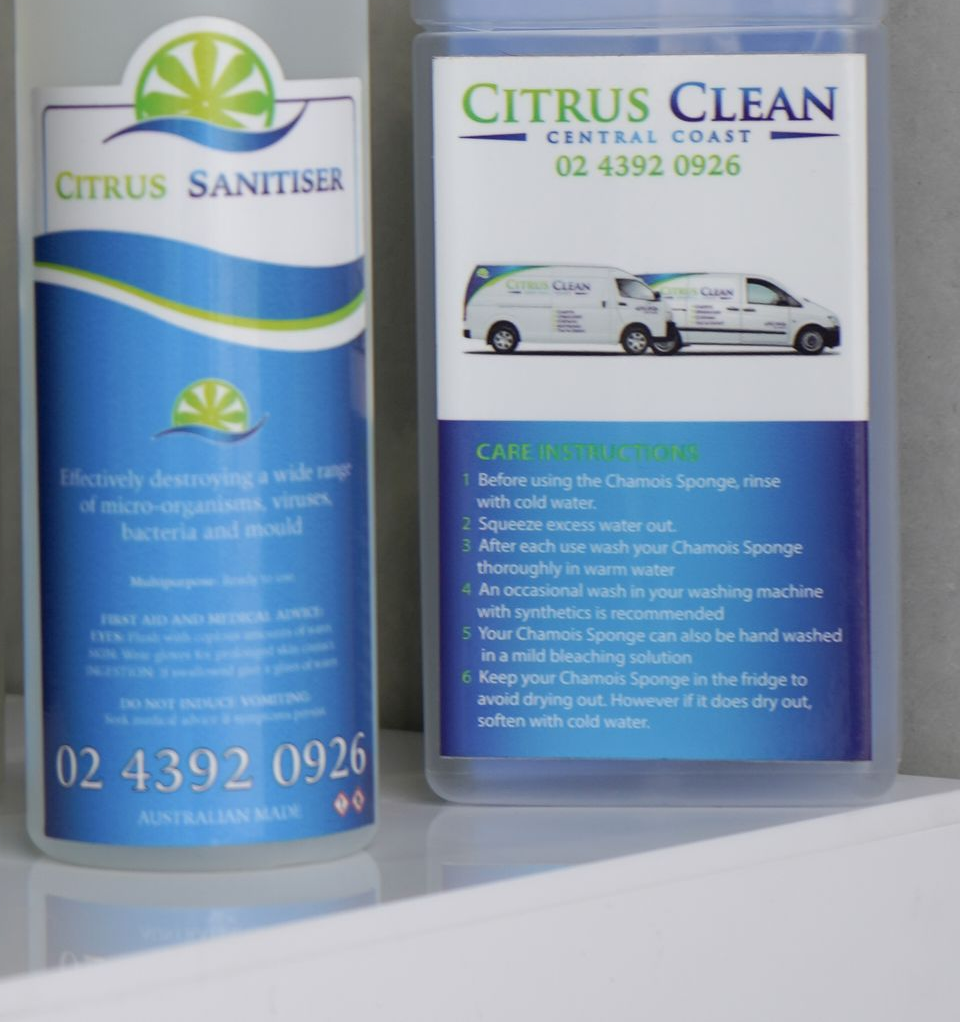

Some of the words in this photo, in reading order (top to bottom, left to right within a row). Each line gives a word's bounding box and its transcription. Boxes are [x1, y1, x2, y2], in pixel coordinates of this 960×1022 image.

[461, 82, 650, 124] CITRUS
[669, 81, 839, 123] CLEAN
[546, 129, 658, 145] CENTRAL
[671, 128, 752, 144] COAST
[555, 154, 588, 177] 02
[597, 154, 665, 177] 4392
[674, 153, 741, 176] 0926
[54, 170, 167, 200] CITRUS
[188, 167, 345, 198] SANITISER
[552, 280, 591, 291] CLEAN
[476, 443, 533, 461] CARE
[539, 443, 700, 463] INSTRUCTIONS
[60, 468, 143, 490] Effectively
[150, 469, 255, 491] destroying
[258, 472, 270, 485] a
[274, 464, 313, 482] wide
[478, 472, 528, 489] Before
[531, 474, 572, 492] using
[576, 473, 602, 489] the
[605, 473, 673, 490] Chamois
[676, 474, 739, 492] Sponge,
[743, 475, 781, 490] rinse
[79, 496, 97, 514] of
[477, 494, 510, 510] with
[514, 495, 547, 510] cold
[550, 497, 597, 511] water.
[121, 521, 198, 542] bacteria
[202, 520, 241, 541] and
[245, 515, 303, 538] mould
[461, 518, 471, 531] 2
[478, 517, 542, 533] Squeeze
[546, 521, 596, 533] excess
[598, 520, 643, 534] water
[645, 521, 677, 534] out.
[461, 539, 471, 553] 3
[478, 538, 516, 554] After
[519, 539, 556, 555] each
[559, 543, 587, 555] use
[590, 539, 629, 555] wash
[632, 543, 668, 559] your
[671, 539, 739, 556] Chamois
[743, 540, 804, 559] Sponge
[477, 560, 562, 580] thoroughly
[566, 561, 580, 576] in
[584, 564, 628, 576] warm
[631, 563, 675, 577] water
[461, 583, 472, 596] 4
[478, 583, 500, 597] An
[504, 582, 583, 599] occasional
[587, 583, 627, 599] wash
[630, 584, 645, 599] in
[648, 586, 684, 602] your
[687, 585, 753, 602] washing
[757, 584, 824, 599] machine
[477, 605, 511, 620] with
[514, 605, 592, 623] synthetics
[596, 606, 608, 621] is
[610, 607, 725, 622] recommended
[461, 627, 471, 641] 5
[478, 627, 513, 641] Your
[516, 626, 583, 642] Chamois
[587, 628, 646, 645] Sponge
[649, 631, 677, 643] can
[681, 628, 712, 643] also
[715, 628, 736, 644] be
[739, 628, 779, 643] hand
[782, 628, 842, 644] washed
[481, 649, 496, 663] in
[499, 652, 509, 663] a
[512, 649, 546, 664] mild
[550, 649, 626, 667] bleaching
[630, 650, 692, 665] solution
[462, 672, 472, 685] 6
[479, 671, 518, 688] Keep
[521, 675, 556, 689] your
[560, 671, 626, 687] Chamois
[630, 671, 689, 690] Sponge
[693, 672, 708, 687] in
[711, 672, 738, 687] the
[741, 672, 788, 690] fridge
[790, 674, 808, 687] to
[477, 693, 520, 707] avoid
[523, 693, 574, 710] drying
[577, 695, 607, 708] out.
[610, 694, 680, 709] However
[683, 693, 695, 708] if
[697, 694, 708, 708] it
[711, 694, 748, 709] does
[751, 694, 778, 711] dry
[781, 696, 812, 711] out,
[477, 714, 526, 728] soften
[529, 714, 564, 729] with
[567, 715, 599, 729] cold
[603, 716, 650, 730] water.
[55, 744, 104, 790] 02
[120, 746, 253, 793] 4392
[271, 731, 367, 787] 0926
